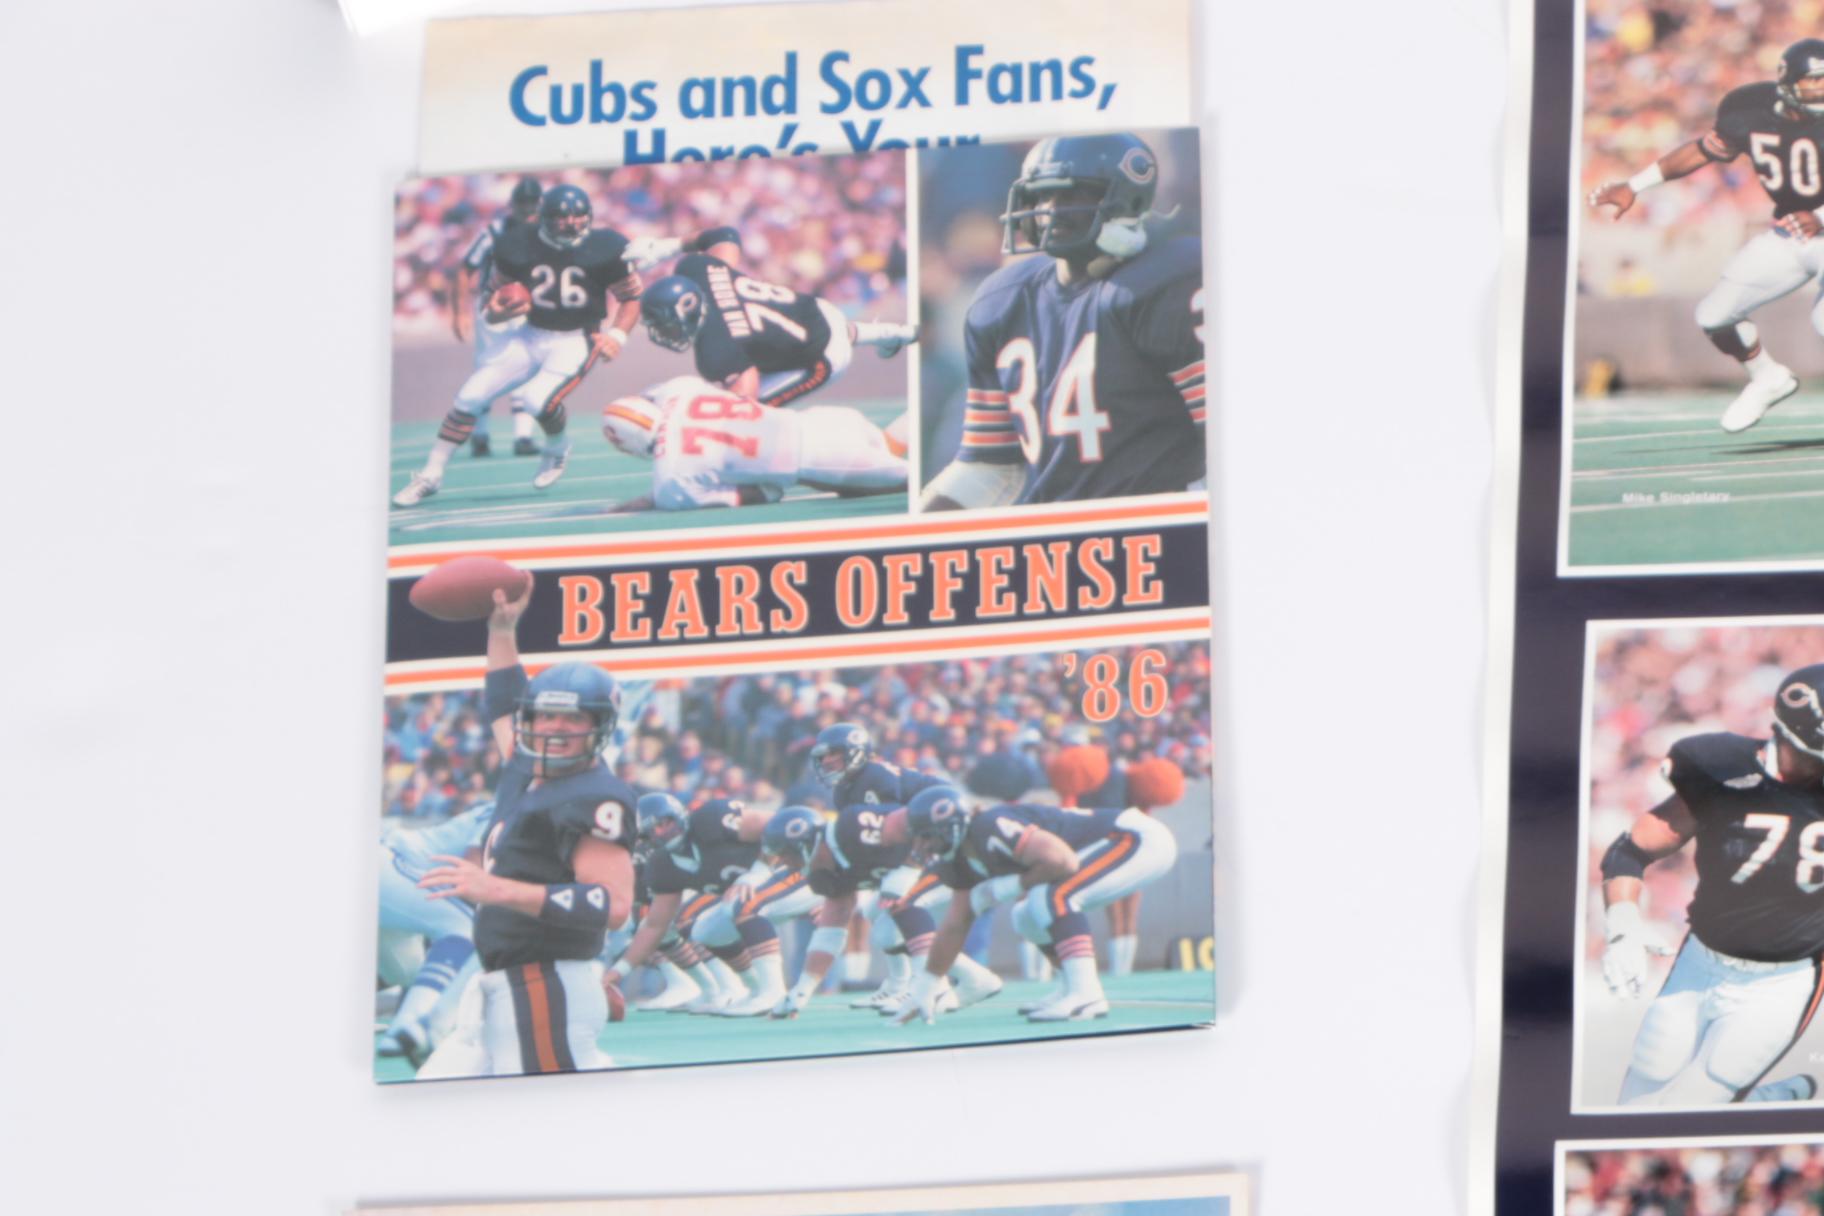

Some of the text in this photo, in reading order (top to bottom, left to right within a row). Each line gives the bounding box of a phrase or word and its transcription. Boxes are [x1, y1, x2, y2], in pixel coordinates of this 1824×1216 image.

[508, 44, 1118, 127] Cubs and Sox Fans,
[1750, 131, 1822, 197] 50
[530, 263, 588, 310] 26
[734, 275, 809, 342] 78
[679, 394, 763, 460] 78
[995, 330, 1113, 465] 34
[1622, 491, 1655, 504] Mike
[557, 533, 1164, 646] BEARS OFFENSE
[1062, 647, 1170, 723] '86
[591, 800, 624, 841] 9
